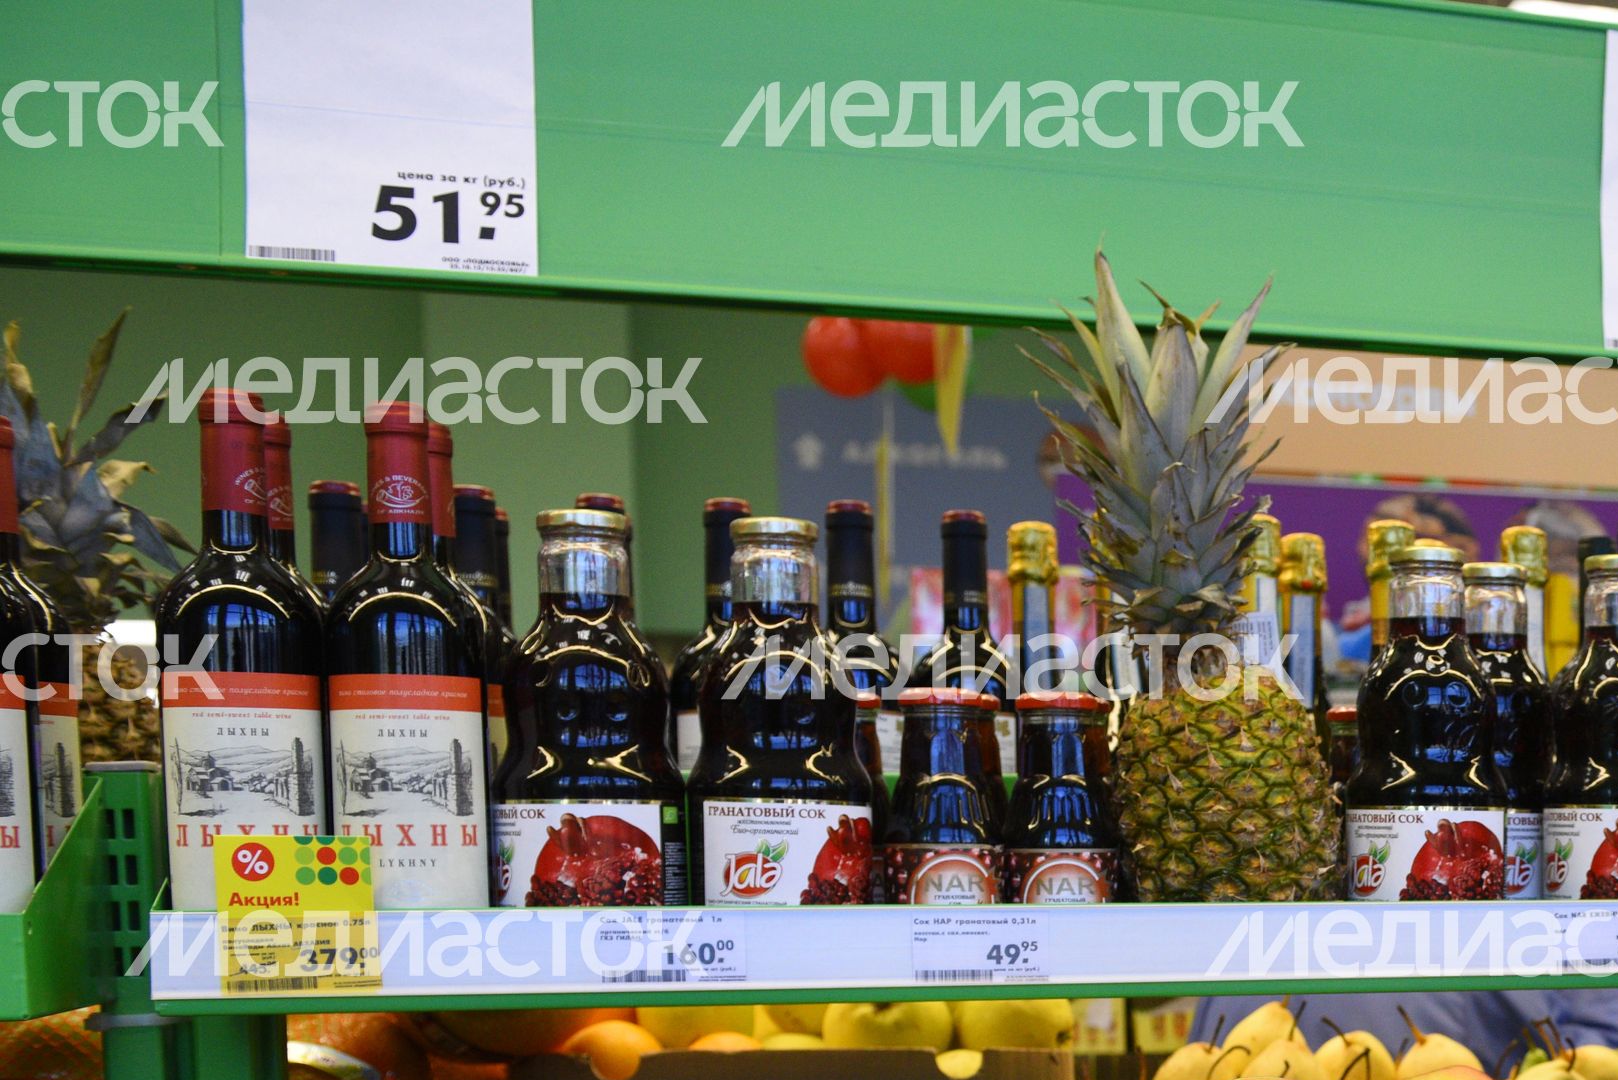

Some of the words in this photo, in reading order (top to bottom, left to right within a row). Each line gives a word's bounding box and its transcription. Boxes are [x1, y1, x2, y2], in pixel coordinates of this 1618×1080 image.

[397, 171, 434, 181] цена
[440, 175, 457, 183] за
[463, 176, 477, 184] кг
[483, 175, 526, 189] (руб.)
[217, 727, 270, 737] ЛЫХНЫ
[377, 729, 428, 738] ЛЫХНЫ
[519, 808, 546, 820] СОК
[708, 805, 795, 819] ГРАНАТОВЫЙ
[798, 808, 827, 819] СОК
[1579, 813, 1603, 822] СОК
[1398, 814, 1425, 824] СОК
[379, 858, 437, 868] LYKHNY
[719, 852, 783, 897] Jala
[924, 873, 985, 893] NAR
[1035, 876, 1096, 896] NAR
[229, 892, 300, 909] Акция!
[600, 916, 618, 924] Сок
[913, 918, 929, 926] Сок
[955, 918, 1009, 927] гранатовый
[1012, 917, 1037, 926] 0,31л
[221, 925, 248, 933] Вино
[251, 922, 292, 932] ЛЫХНЫ
